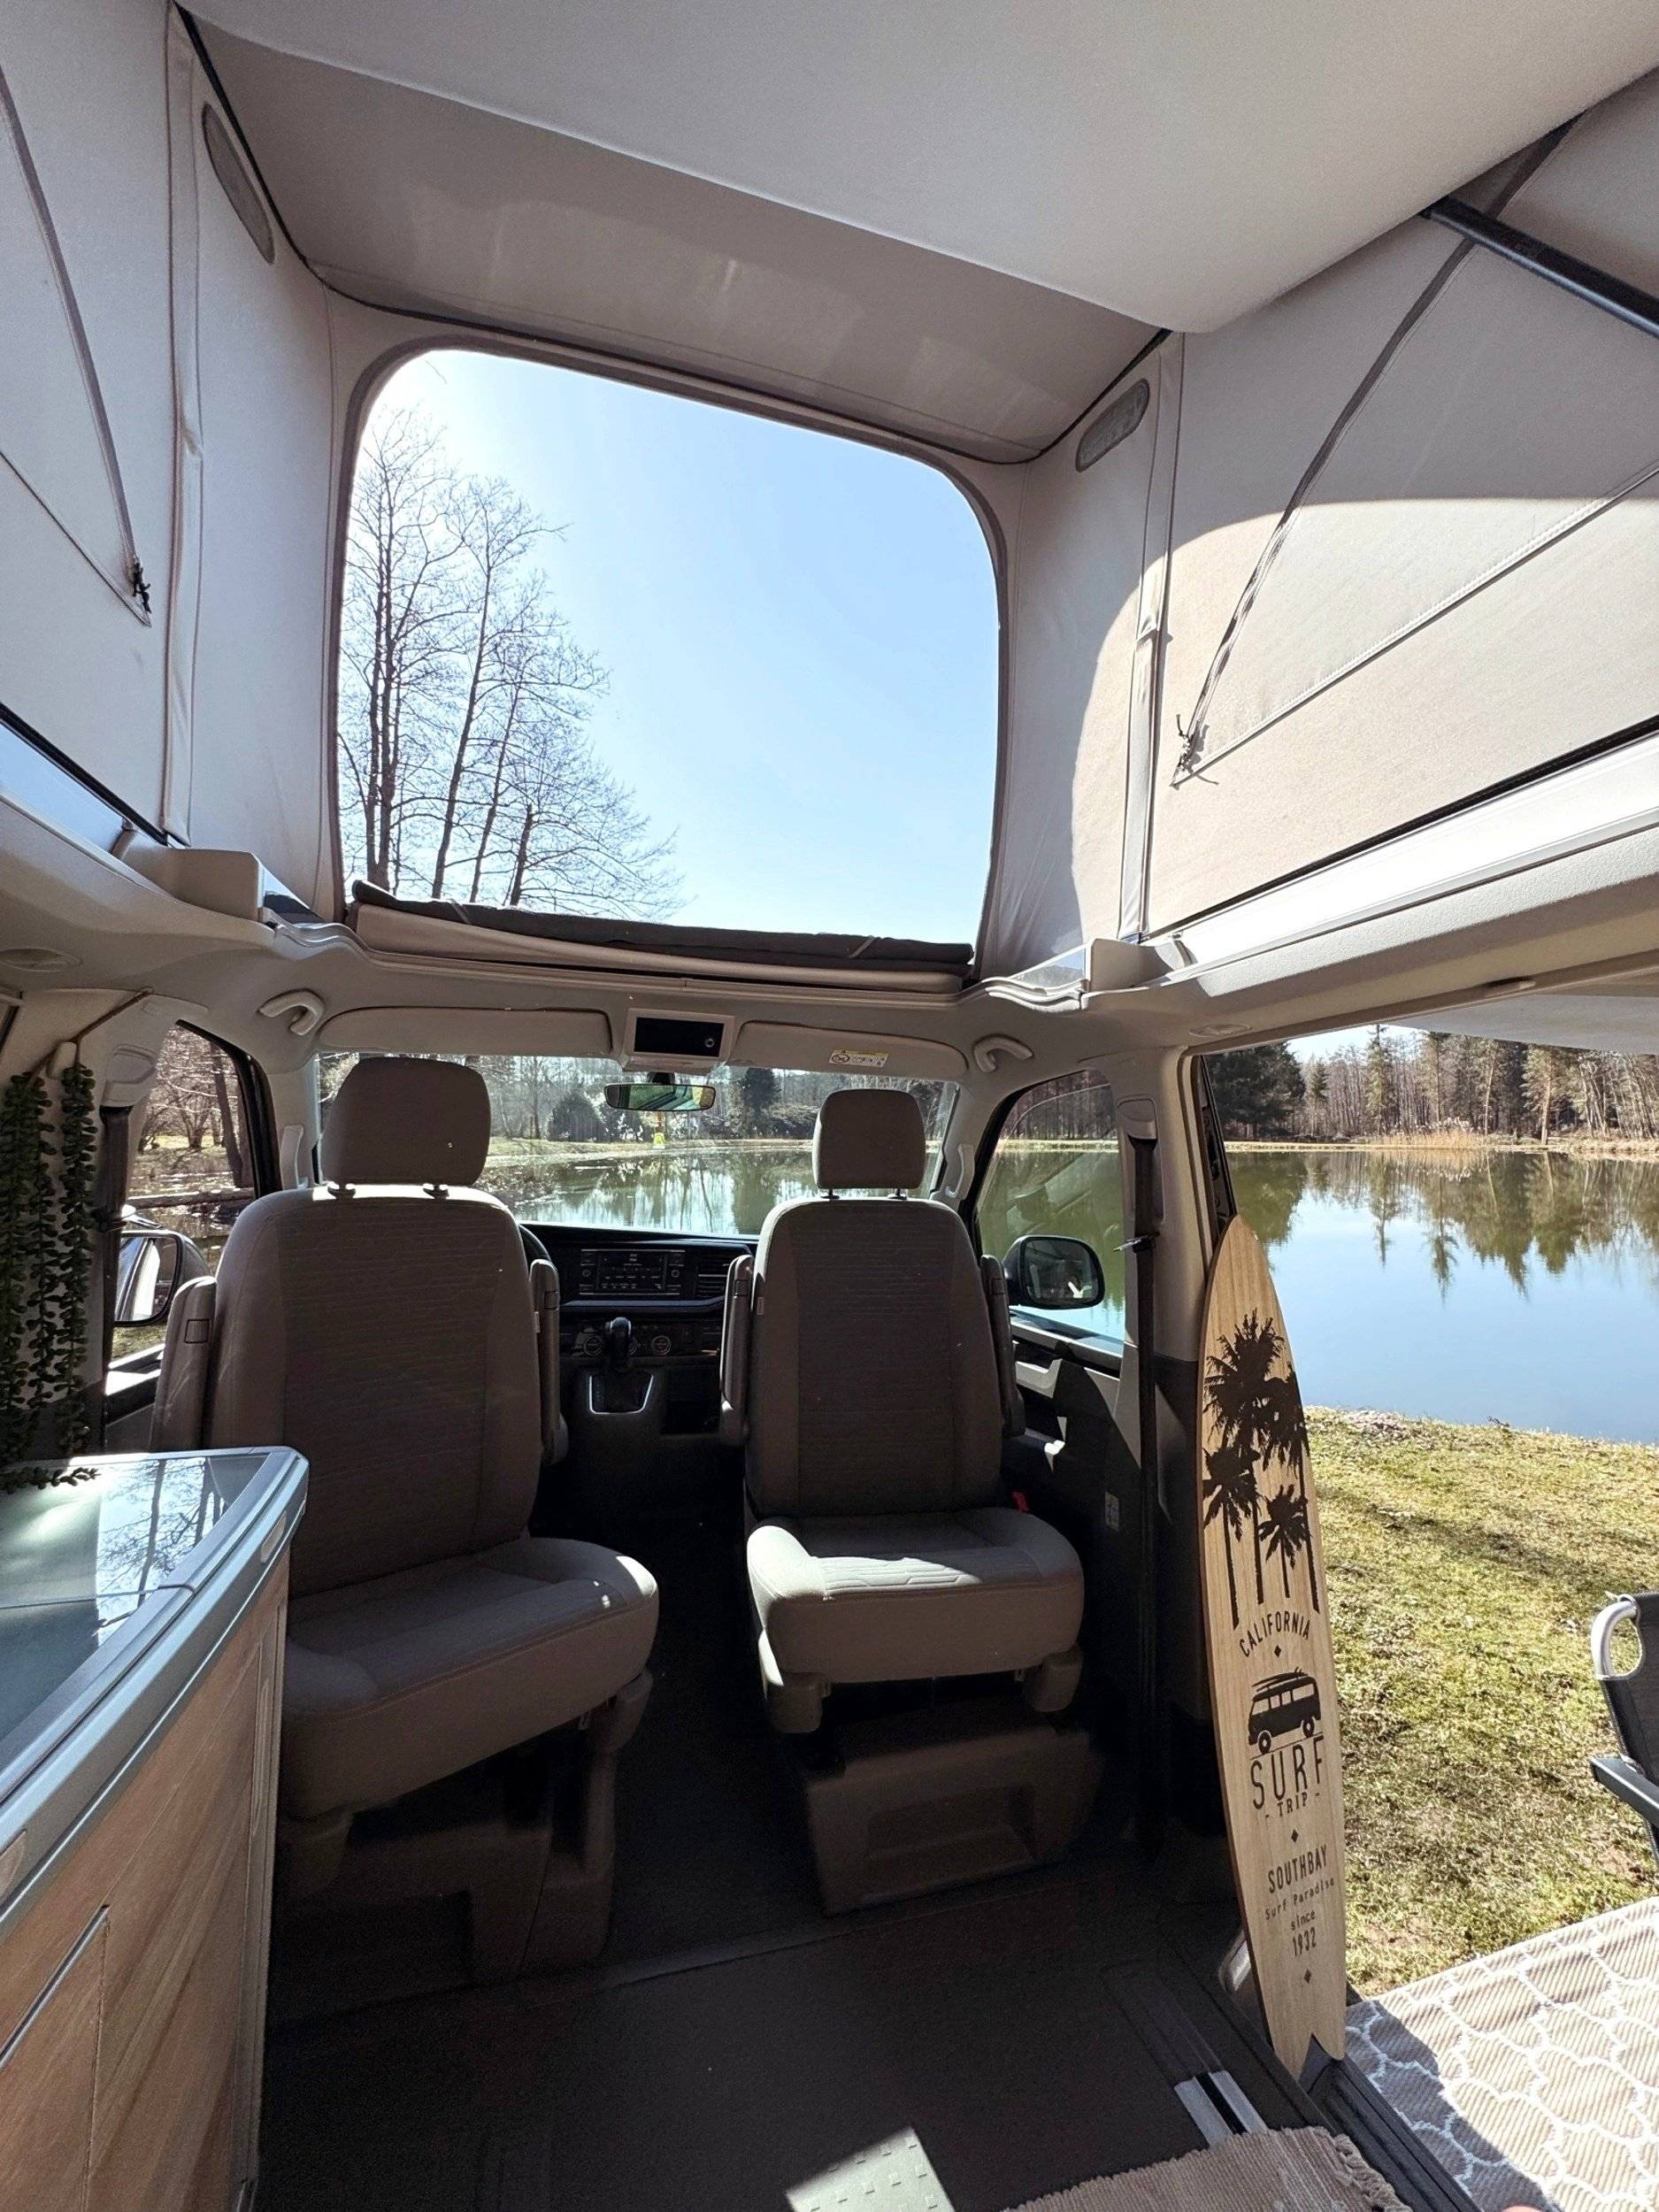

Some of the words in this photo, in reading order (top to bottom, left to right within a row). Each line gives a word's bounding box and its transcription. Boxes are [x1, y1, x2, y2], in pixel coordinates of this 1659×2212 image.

[1240, 1611, 1310, 1657] CALIFORNIA
[1250, 1735, 1325, 1809] SURF
[1277, 1792, 1308, 1817] TRIP
[1268, 1845, 1327, 1893] SOUTHBAY
[1291, 1910, 1316, 1931] since
[1292, 1927, 1317, 1956] 1932
